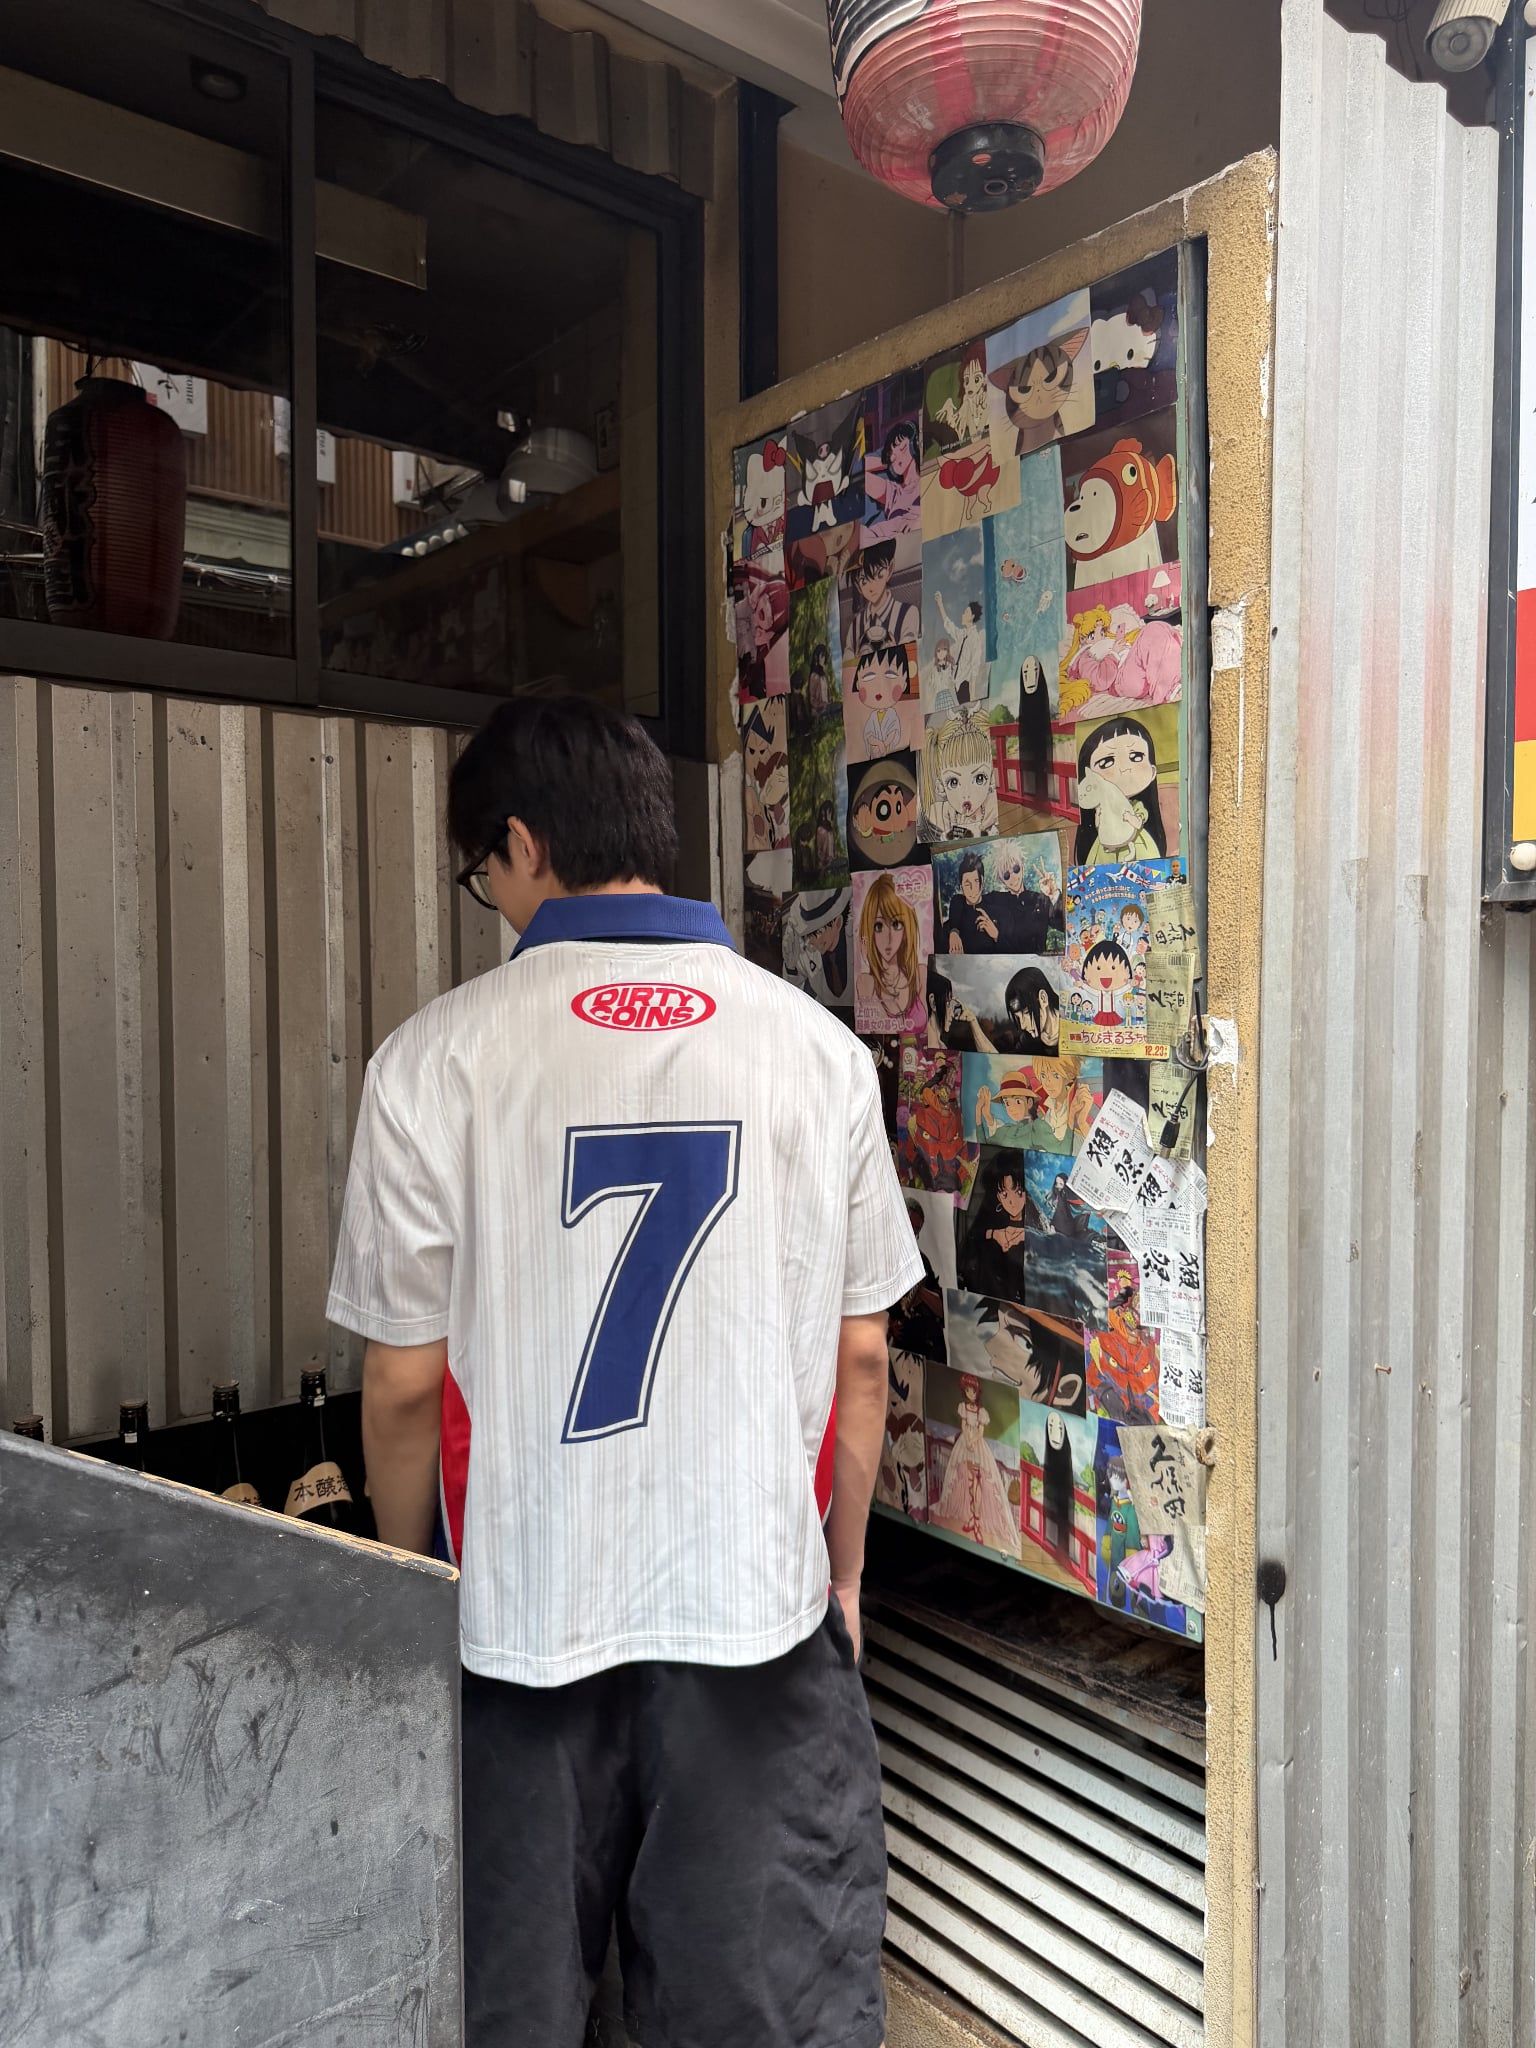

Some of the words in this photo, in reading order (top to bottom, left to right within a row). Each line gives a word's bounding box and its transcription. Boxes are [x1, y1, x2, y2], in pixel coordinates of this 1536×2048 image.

[592, 987, 694, 1006] DIRTY
[589, 1005, 695, 1028] COINS
[1145, 1045, 1164, 1057] 12.23
[561, 1120, 743, 1444] 7
